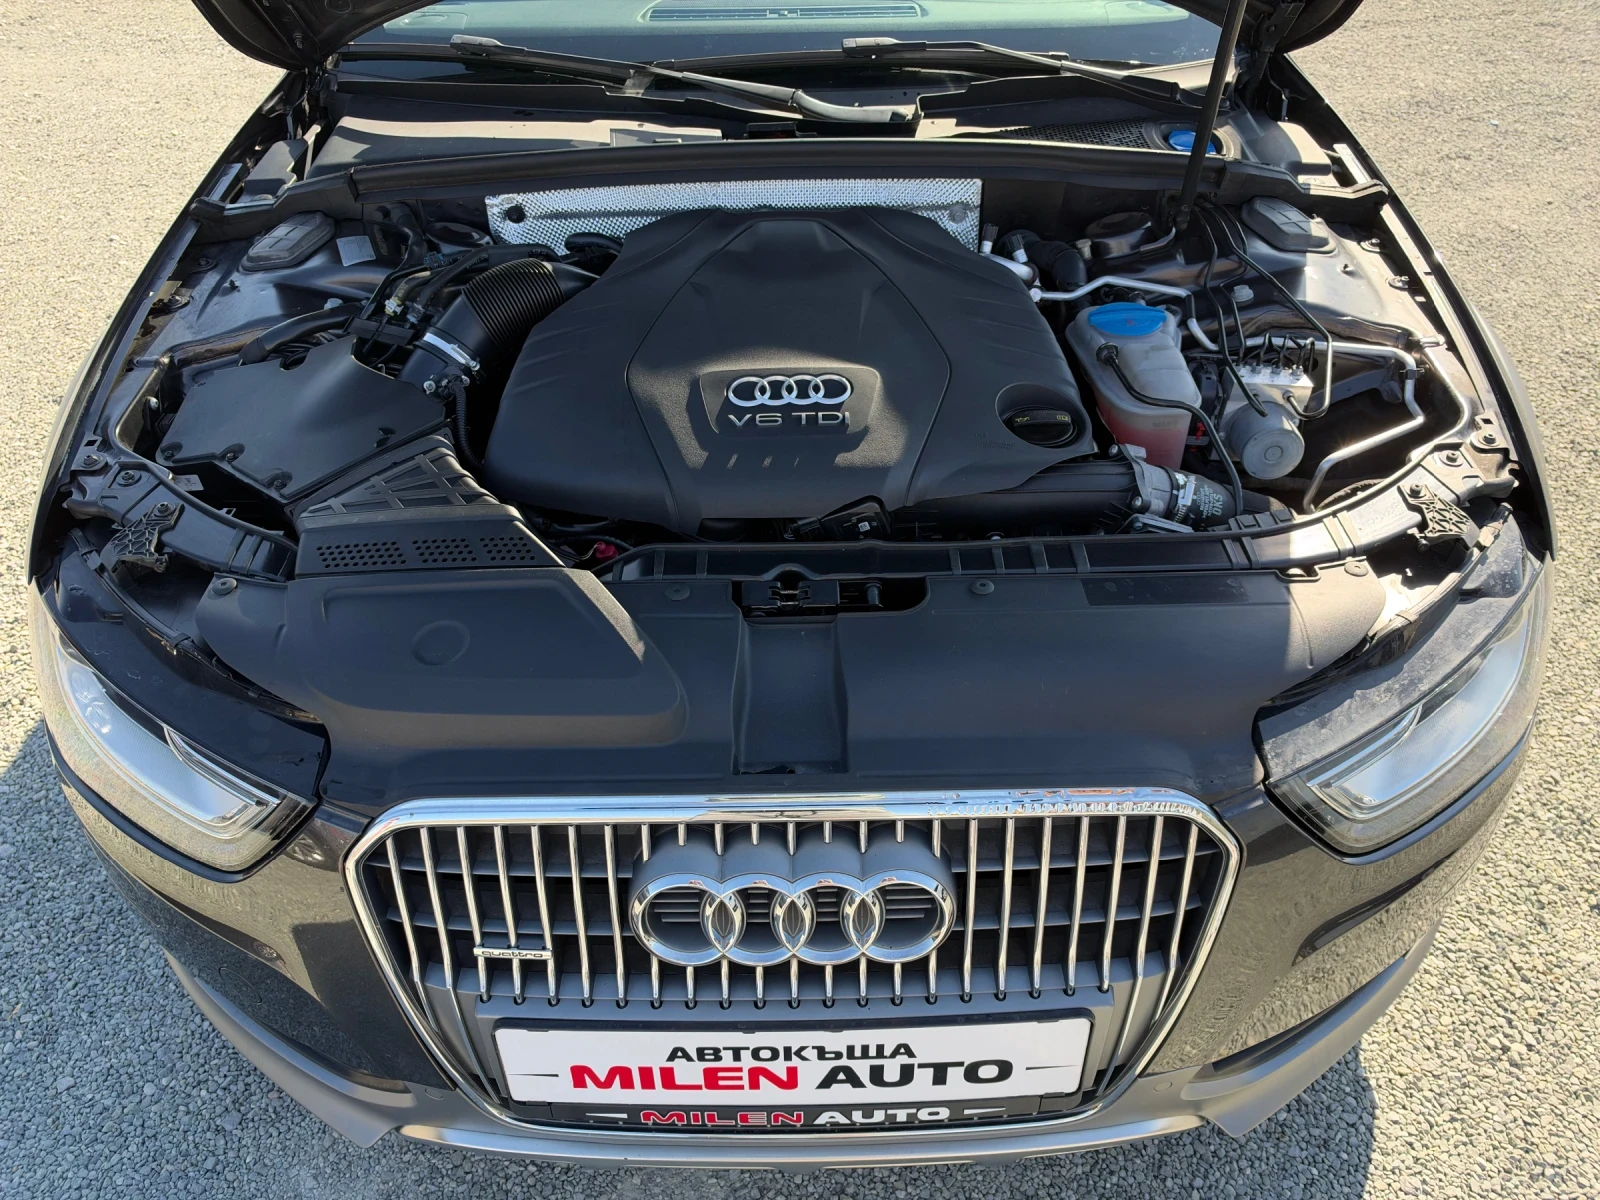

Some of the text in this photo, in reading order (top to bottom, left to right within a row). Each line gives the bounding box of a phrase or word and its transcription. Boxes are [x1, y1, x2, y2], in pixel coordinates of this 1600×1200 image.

[728, 411, 850, 426] V6 TDI
[481, 950, 544, 958] quattro
[569, 1059, 1014, 1091] MILEN AUTO
[640, 1107, 950, 1126] MILEN AUTO
